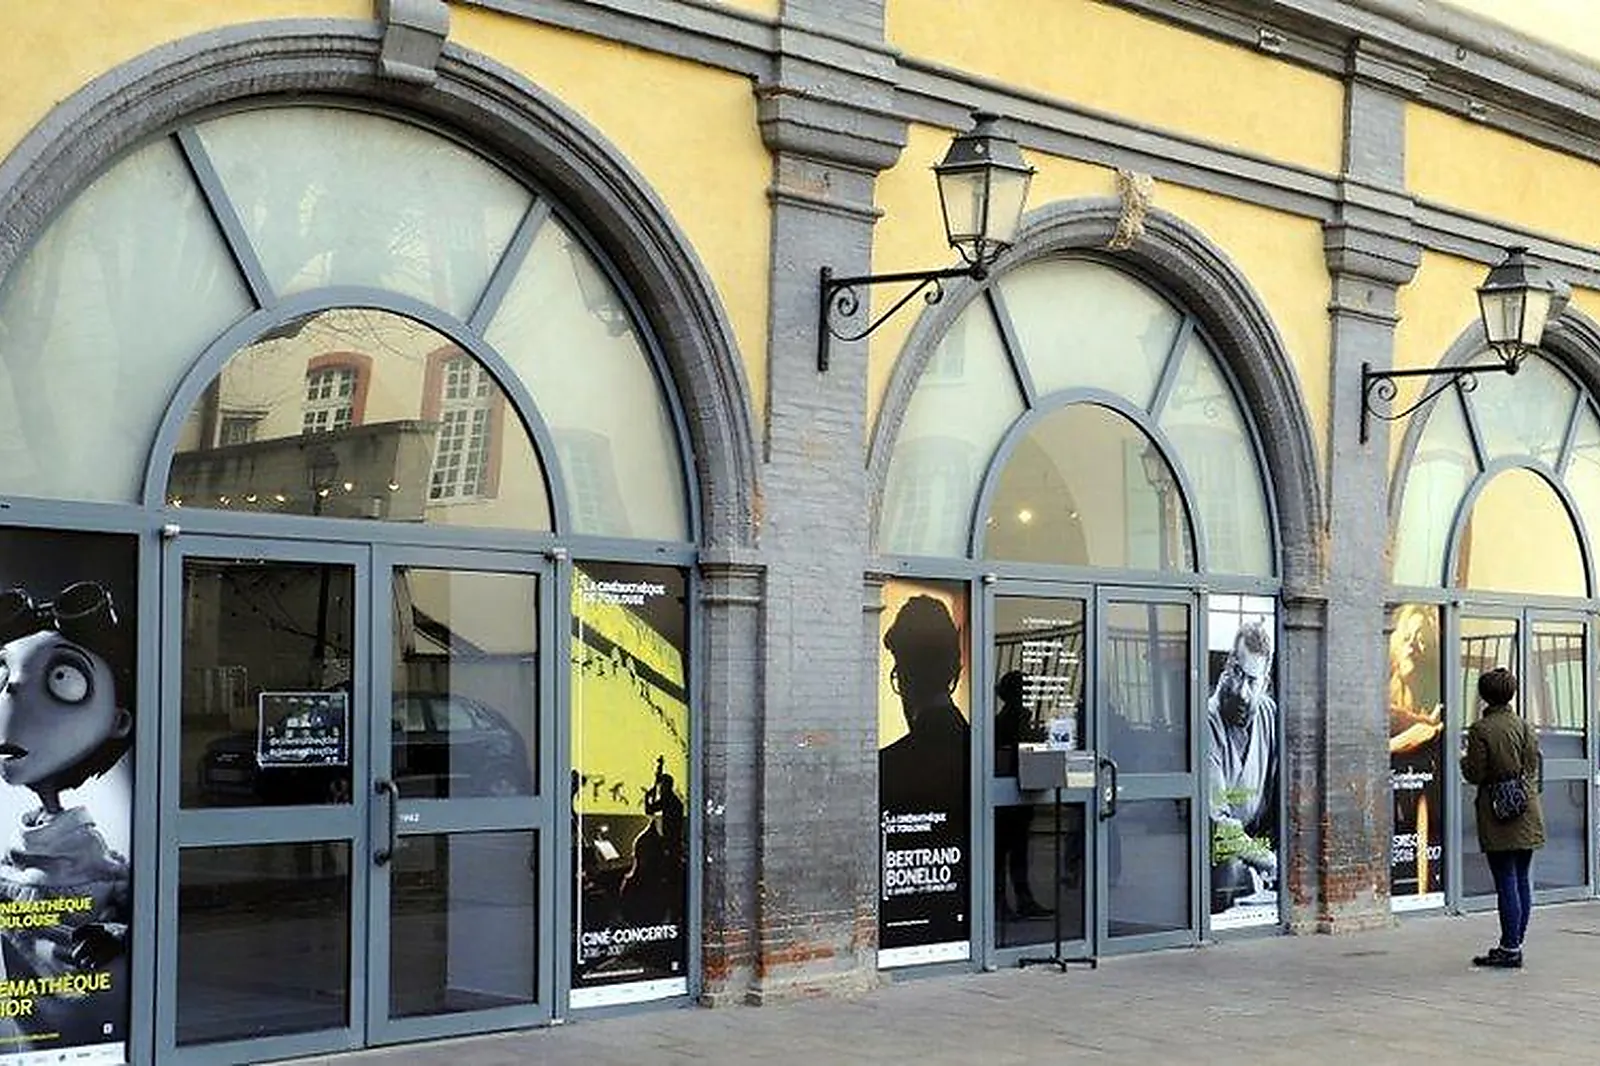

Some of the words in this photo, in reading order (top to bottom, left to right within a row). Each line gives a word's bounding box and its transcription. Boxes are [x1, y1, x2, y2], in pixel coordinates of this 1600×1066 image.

[886, 847, 961, 868] BERTRAND
[886, 865, 951, 886] BONELLO
[582, 927, 677, 946] CINÉ-CONCERTS
